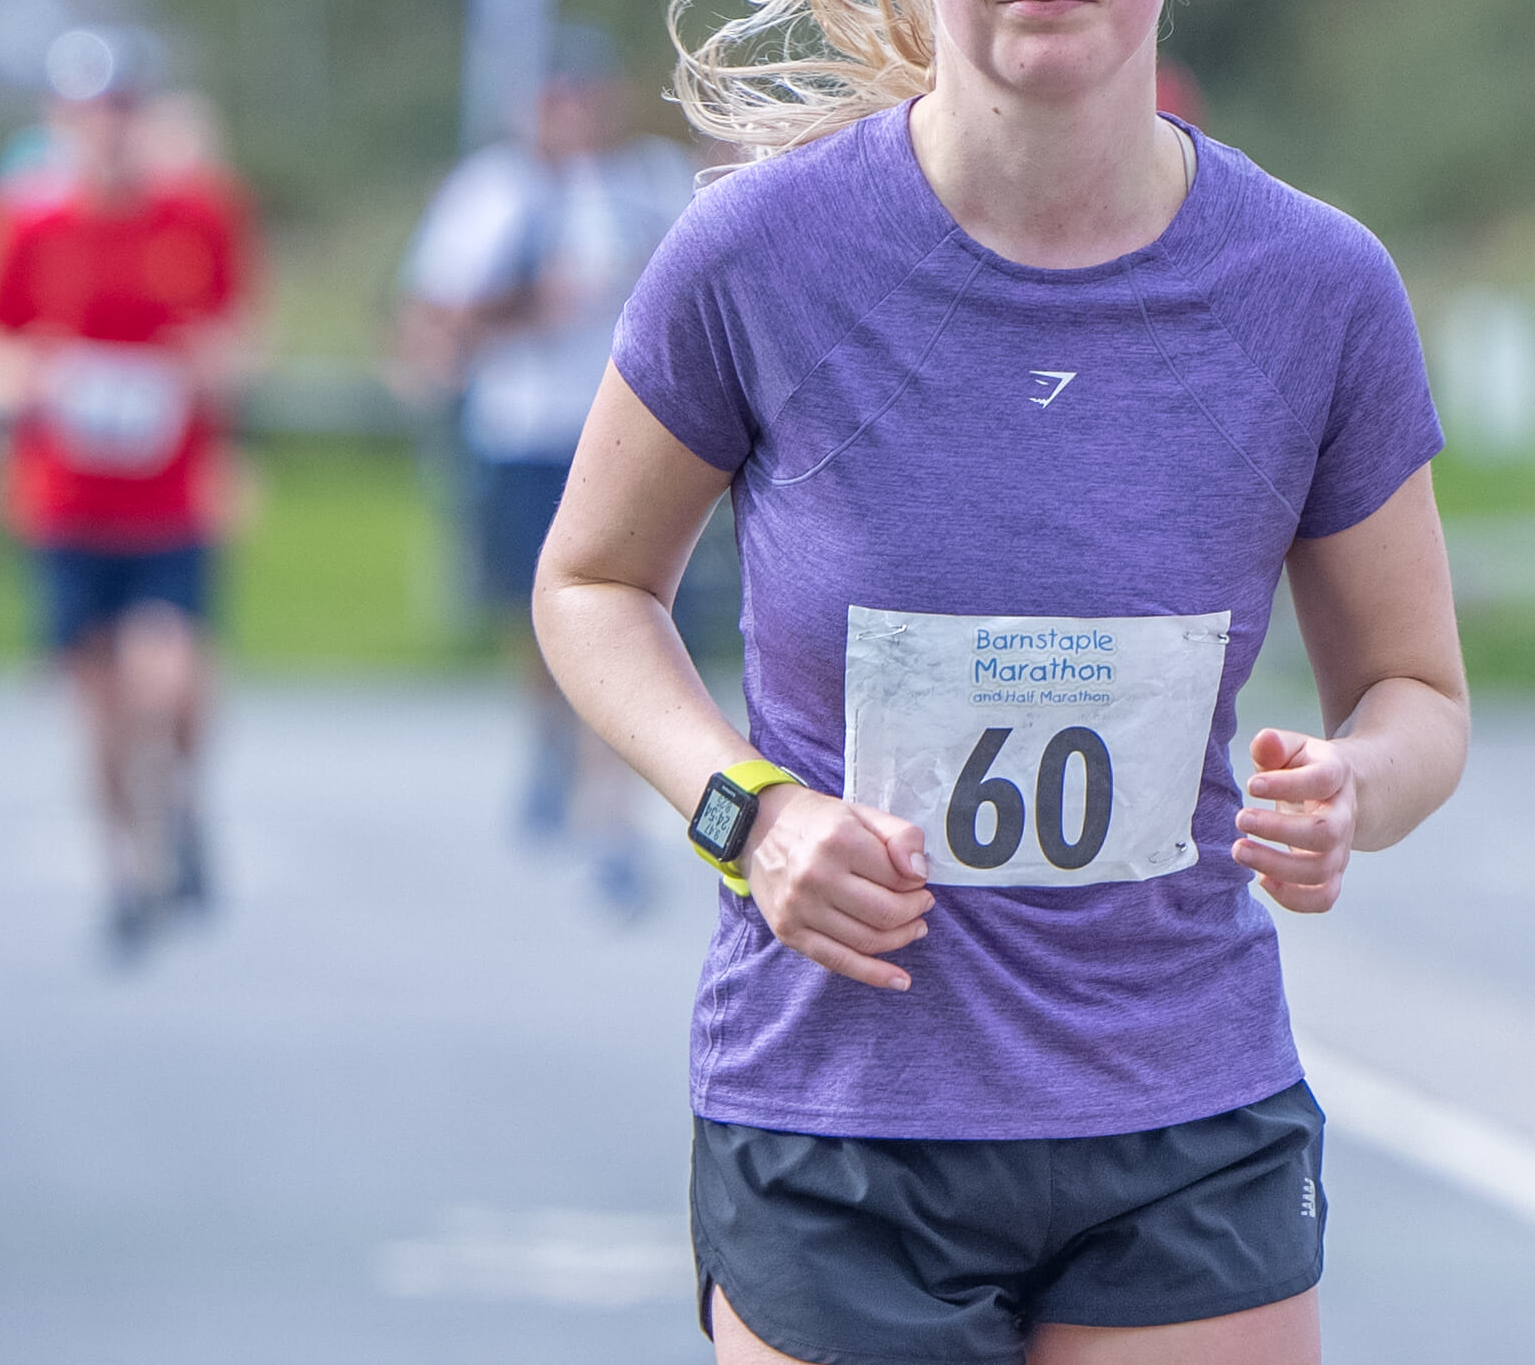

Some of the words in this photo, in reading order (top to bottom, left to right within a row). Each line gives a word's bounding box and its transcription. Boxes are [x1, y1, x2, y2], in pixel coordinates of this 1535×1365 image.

[976, 628, 1114, 653] Barnstaple
[974, 658, 1113, 683] Marathon
[972, 690, 1003, 704] and
[1004, 690, 1037, 705] Half
[1040, 690, 1111, 705] Marathon
[946, 726, 1114, 871] 60
